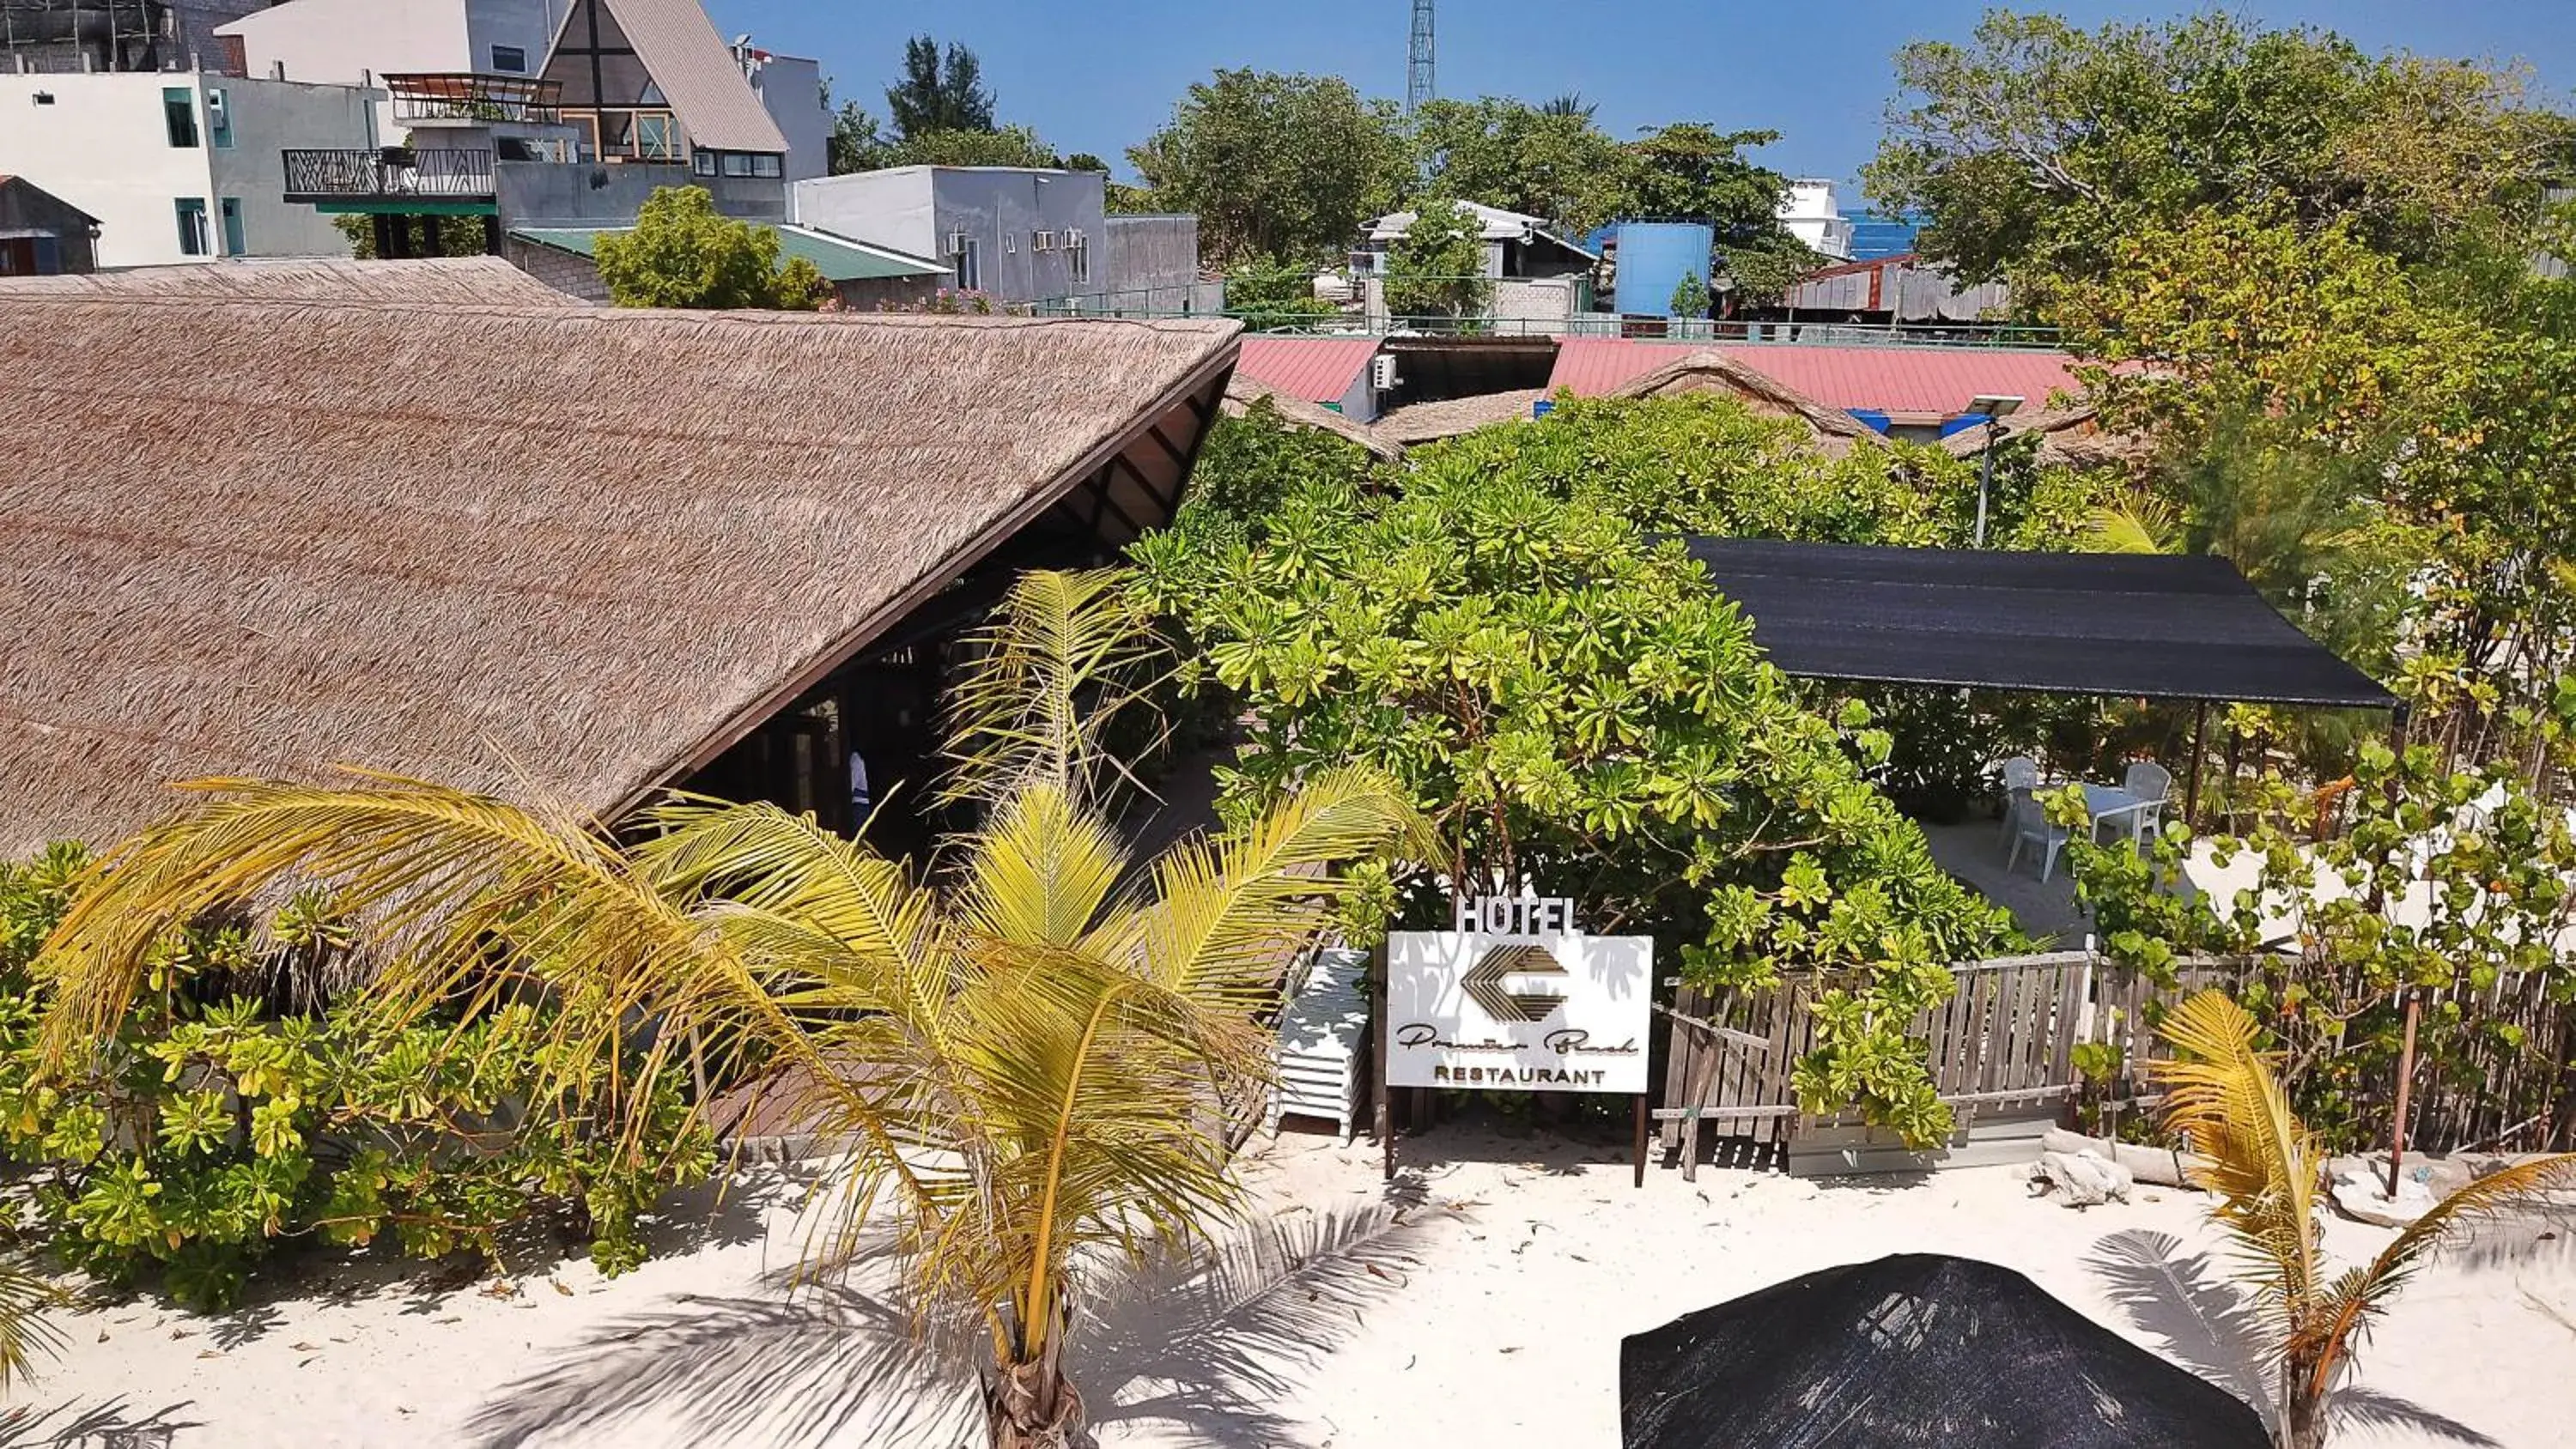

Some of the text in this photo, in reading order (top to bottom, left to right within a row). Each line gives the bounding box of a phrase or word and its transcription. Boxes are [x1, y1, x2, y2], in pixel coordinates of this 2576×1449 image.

[1456, 895, 1583, 936] HOTEL
[1544, 1029, 1639, 1054] Beach
[1434, 1064, 1606, 1085] RESTAURANT
